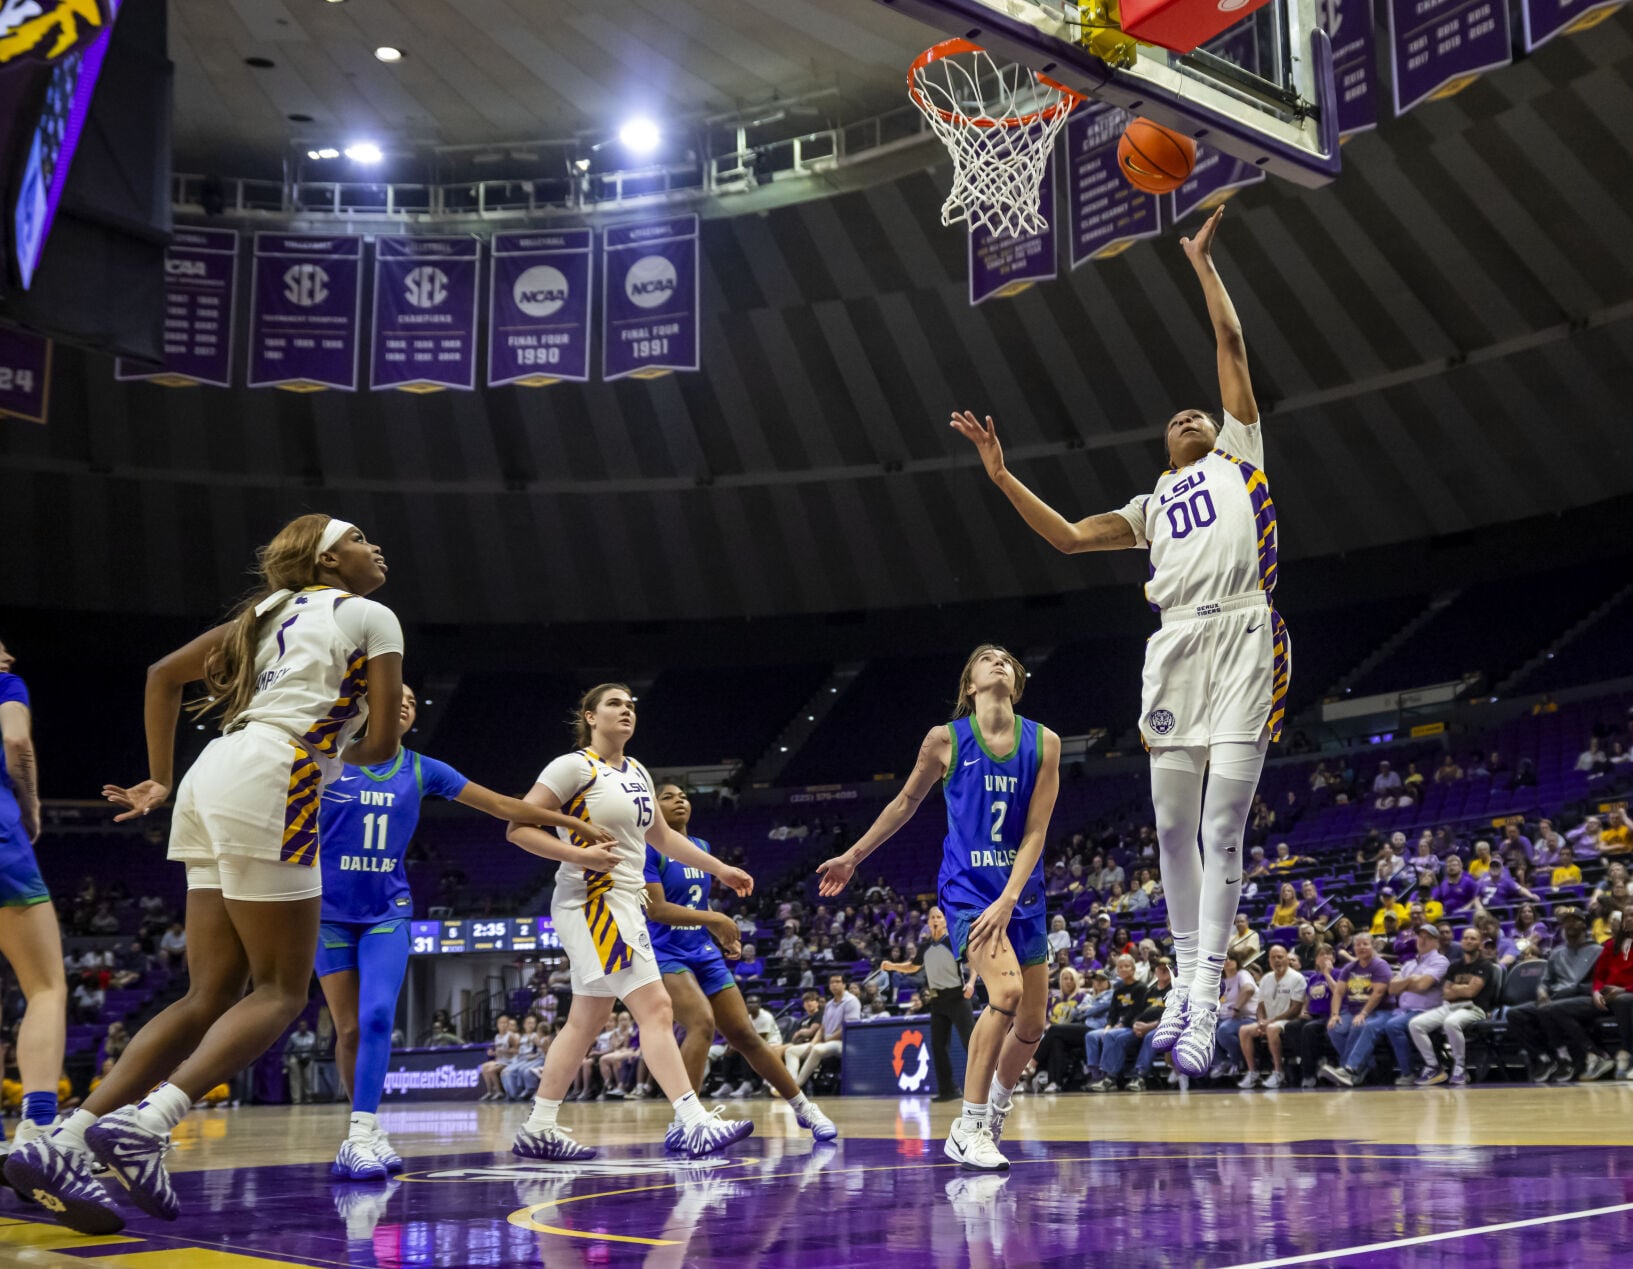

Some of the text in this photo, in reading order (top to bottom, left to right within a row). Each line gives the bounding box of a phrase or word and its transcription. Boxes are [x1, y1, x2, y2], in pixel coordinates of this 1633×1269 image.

[283, 263, 330, 307] SEC
[404, 266, 448, 308] SEC
[631, 278, 673, 296] NCAA
[518, 289, 565, 303] NCAA
[508, 333, 569, 347] FINAL FOUR
[621, 323, 679, 341] FINAL FOUR
[516, 347, 560, 365] 1990
[632, 339, 668, 358] 1991
[1160, 471, 1206, 505] LSU
[1166, 489, 1217, 539] 00
[620, 783, 647, 794] LSU
[984, 775, 1018, 793] UNT
[360, 790, 395, 807] UNT
[633, 796, 653, 828] 15
[991, 801, 1008, 842] 2
[363, 813, 388, 850] 11
[1482, 886, 1498, 905] 7
[449, 927, 458, 938] 5
[473, 923, 506, 936] 2:35
[520, 925, 529, 936] 2
[414, 936, 434, 952] 31
